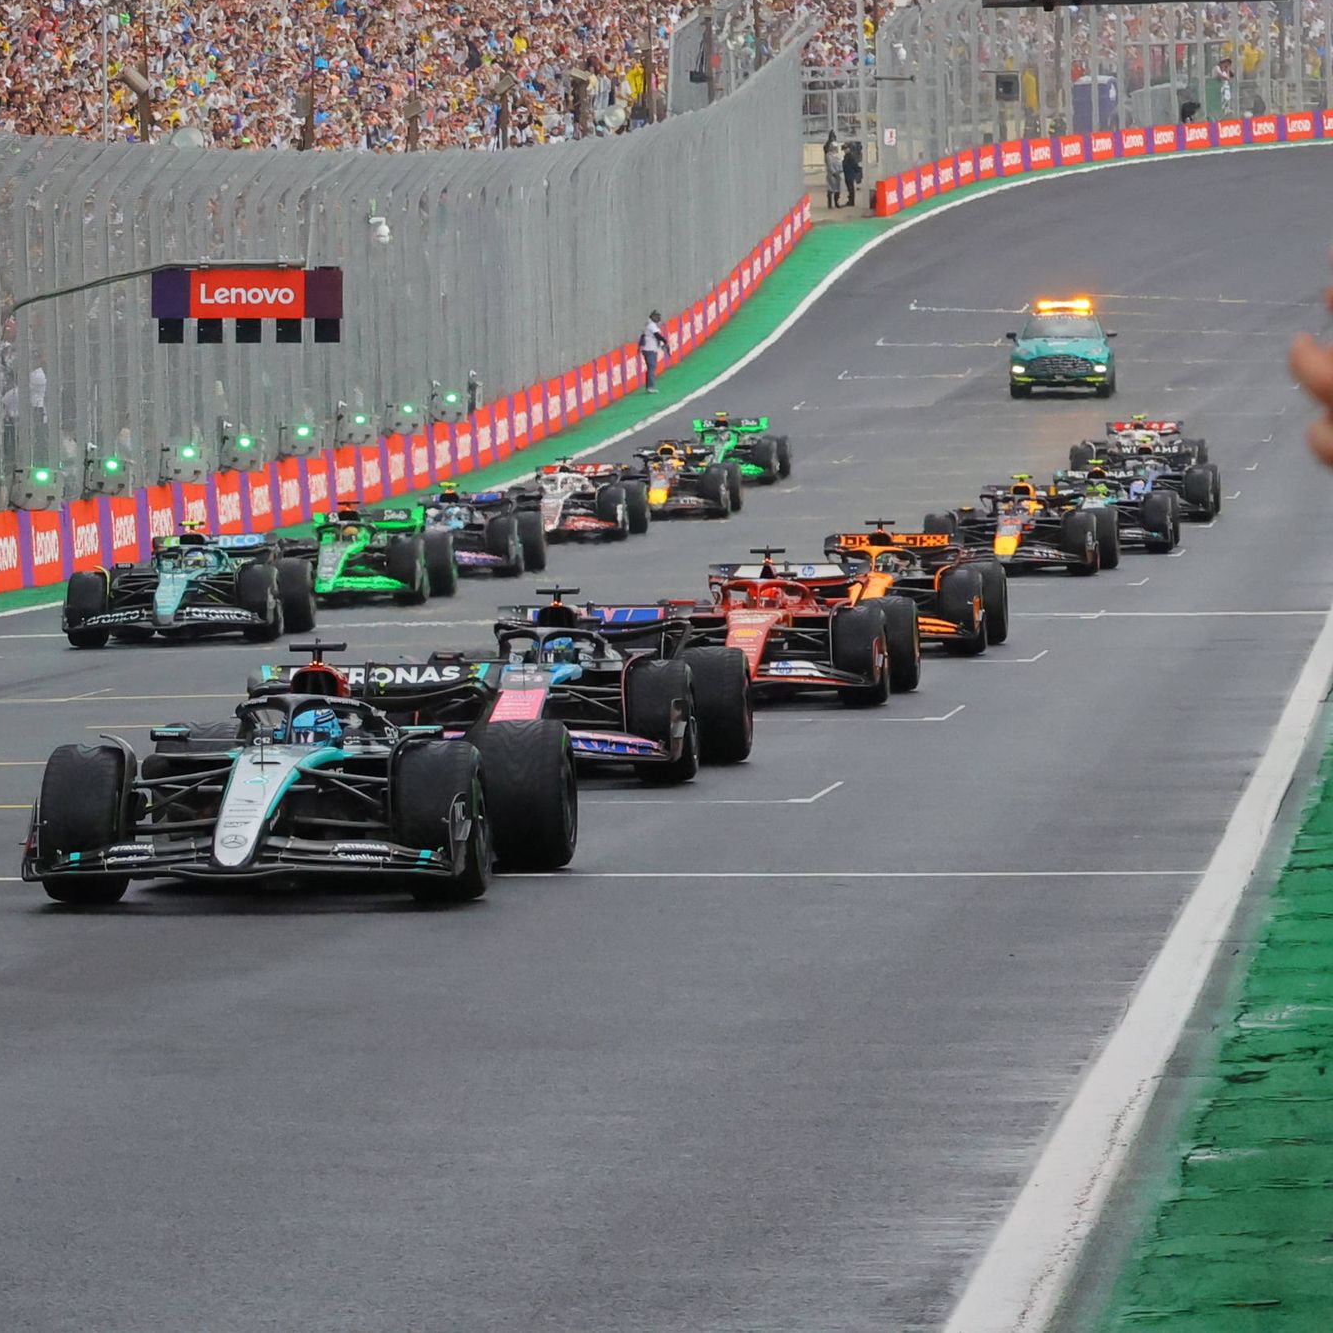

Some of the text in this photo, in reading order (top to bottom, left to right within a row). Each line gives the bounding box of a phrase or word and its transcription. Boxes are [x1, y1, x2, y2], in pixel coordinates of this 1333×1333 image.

[200, 283, 295, 304] Lenovo
[32, 525, 59, 566] Lenovo
[71, 518, 99, 559] Lenovo
